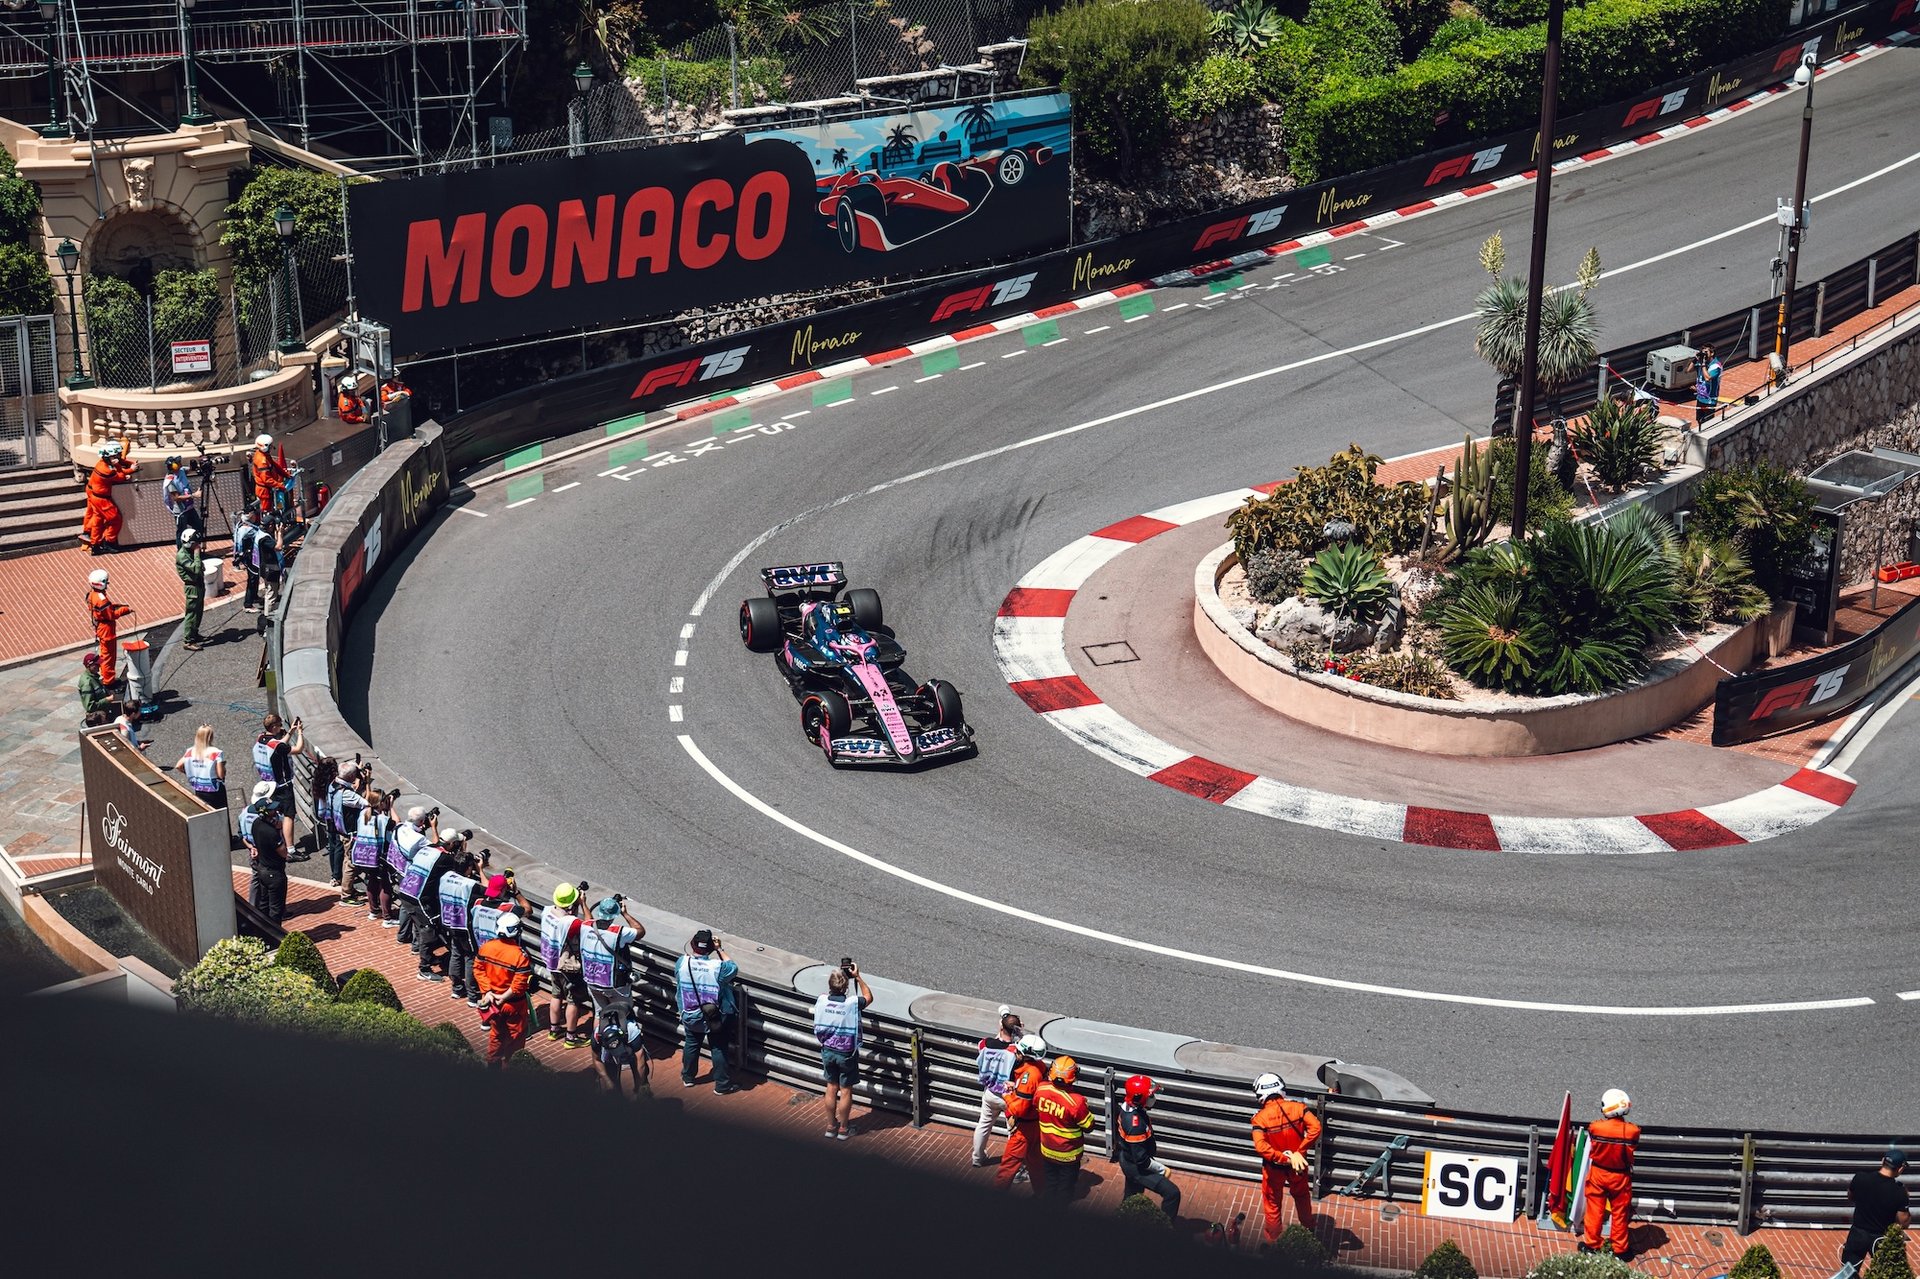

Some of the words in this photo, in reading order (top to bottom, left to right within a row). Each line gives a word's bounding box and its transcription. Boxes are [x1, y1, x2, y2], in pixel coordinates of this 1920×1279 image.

[1834, 21, 1865, 52] Monaco
[1621, 96, 1664, 128] F1
[1659, 87, 1690, 116] 75
[1707, 71, 1742, 105] Monaco
[1423, 153, 1475, 187] F1
[1470, 143, 1508, 174] 75
[1192, 214, 1250, 252] F1
[1247, 204, 1289, 237] 75
[1317, 187, 1373, 225] Monaco
[401, 170, 791, 313] MONACO
[1072, 252, 1136, 291] Monaco
[930, 283, 995, 323] F1
[990, 271, 1038, 307] 75
[790, 325, 862, 366] Monaco
[630, 357, 704, 399] F1
[699, 345, 751, 381] 75
[611, 421, 796, 482] TAXIS
[401, 470, 441, 530] Monaco
[364, 512, 382, 575] 75
[1748, 676, 1818, 721] F1
[1809, 664, 1852, 706] 75
[102, 801, 166, 889] Fairmont
[117, 855, 135, 880] MONTE
[135, 873, 154, 896] CARLO
[1038, 1096, 1065, 1119] CSPM
[1438, 1163, 1506, 1211] SC
